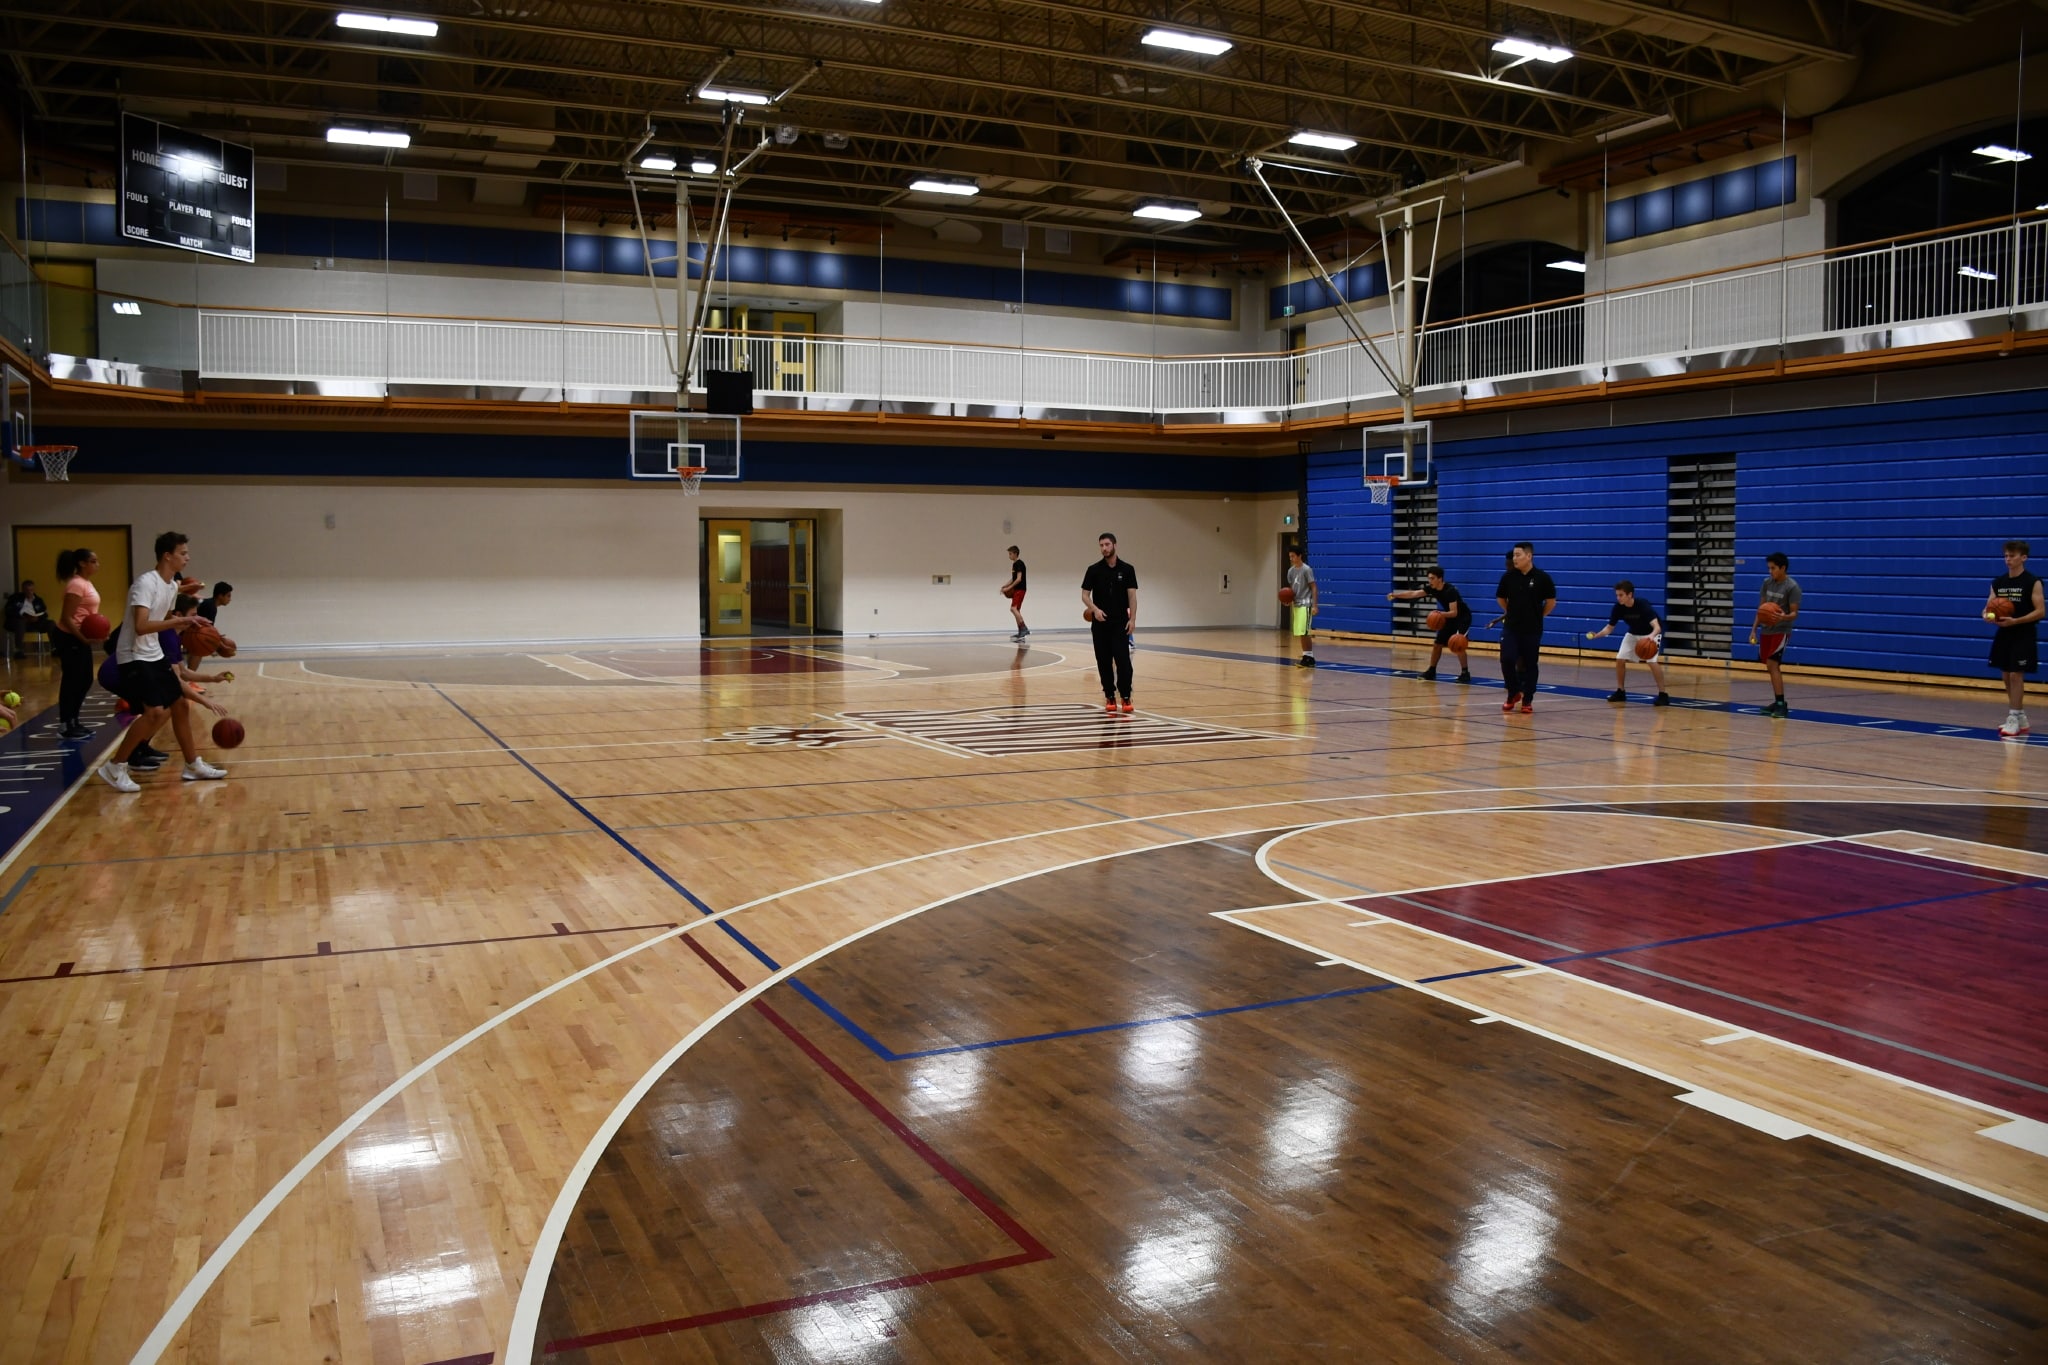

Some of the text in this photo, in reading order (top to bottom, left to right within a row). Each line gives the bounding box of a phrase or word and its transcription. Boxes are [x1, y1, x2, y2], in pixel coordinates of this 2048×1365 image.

[132, 149, 161, 167] HOME
[218, 172, 248, 189] GUEST
[126, 191, 149, 204] FOULS
[168, 201, 213, 219] PLAYER FOUL
[231, 215, 251, 227] FOULS
[126, 225, 149, 237] SCORE
[180, 236, 203, 249] MATCH
[231, 247, 251, 259] SCORE
